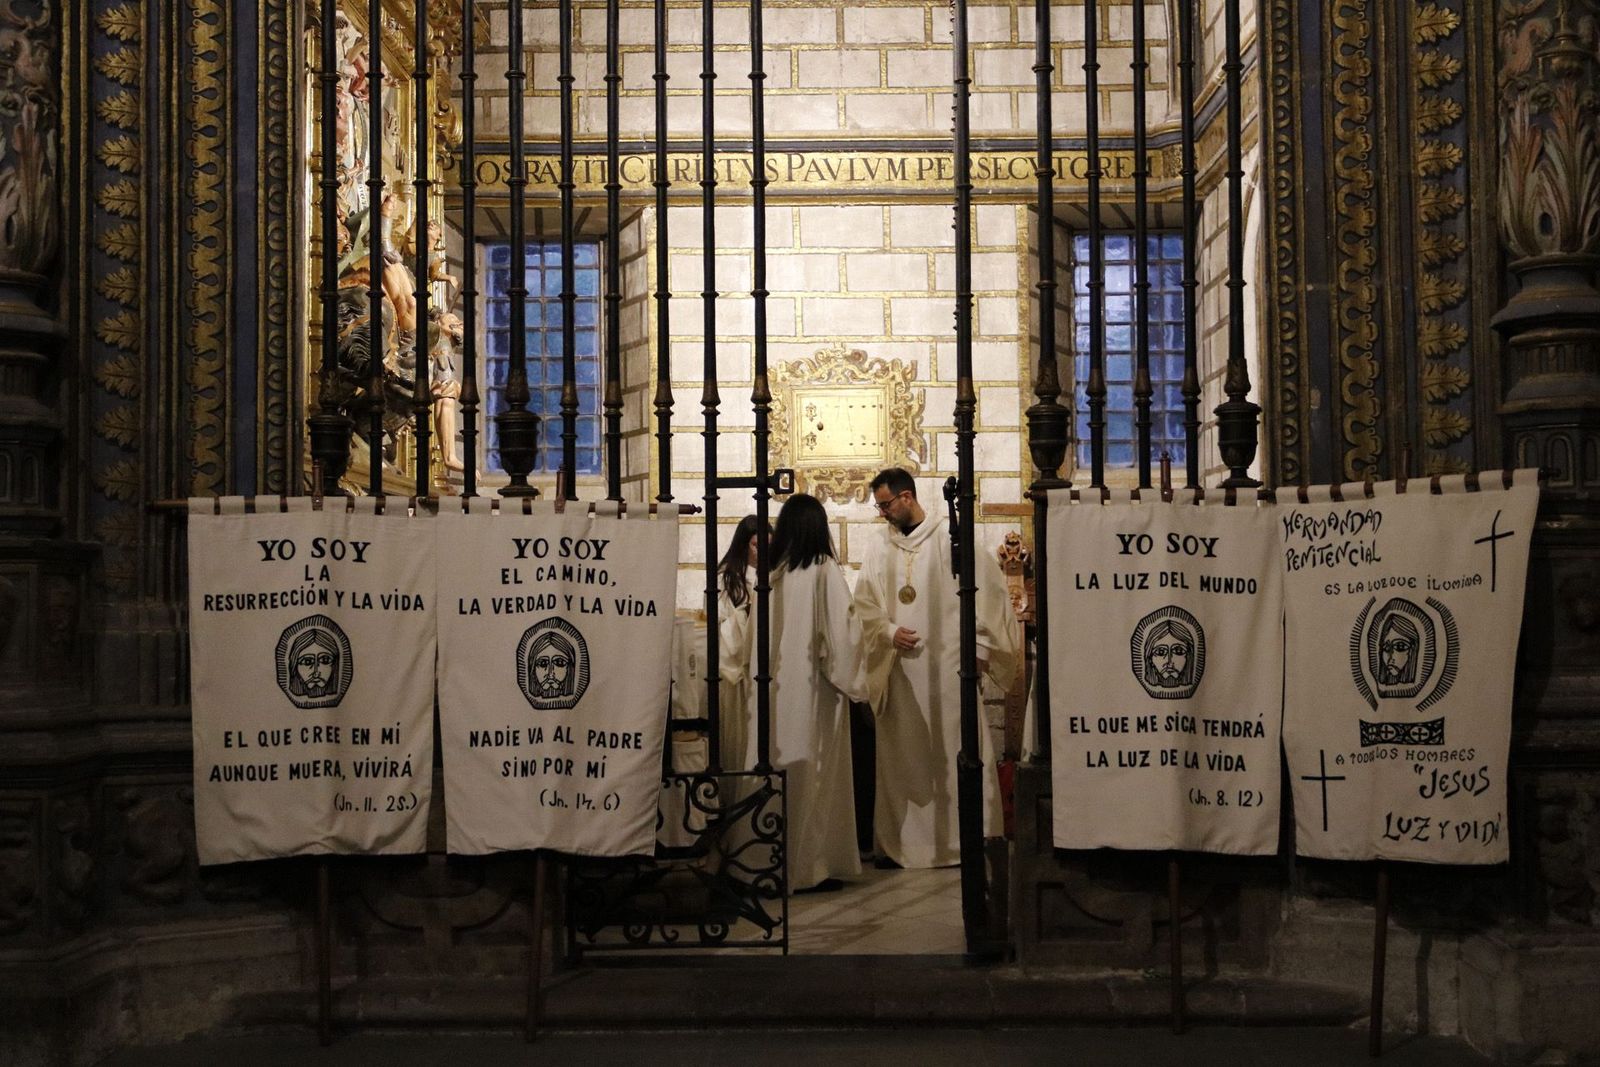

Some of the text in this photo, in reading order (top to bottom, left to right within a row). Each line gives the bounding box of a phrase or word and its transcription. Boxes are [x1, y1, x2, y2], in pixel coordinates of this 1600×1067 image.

[784, 153, 907, 182] PAVLVM
[1283, 509, 1382, 543] HERMANDAD
[257, 538, 371, 563] YO SOY
[512, 537, 610, 560] YO SOY
[1116, 533, 1219, 557] YO SOY
[1286, 539, 1381, 573] PENITENCIAL
[305, 565, 330, 582] LA
[502, 564, 616, 586] EL CAMINO,
[1076, 572, 1257, 594] LA LUZ DEL MUNDO
[1325, 574, 1482, 595] ES LA LUZ QUE ILUMINA
[204, 584, 424, 611] RESURRECCIÓN Y LA VIDA
[459, 594, 656, 616] LA VERDAD Y LA VIDA
[224, 722, 400, 748] EL QUE CREE EN MÍ
[1070, 712, 1264, 738] EL QUE ME SIGA TENDRÁ
[470, 726, 642, 749] NADIE VA AL PADRE
[209, 754, 412, 782] AUNQUE MUERA, VIVIRÁ
[502, 755, 606, 778] SINO POR MÍ
[1087, 749, 1246, 772] LA LUZ DE LA VIDA
[1336, 754, 1344, 765] A
[1406, 748, 1475, 762] HOMBRES
[540, 789, 568, 808] (Jn.
[604, 792, 620, 810] 6)
[1217, 790, 1228, 806] 8.
[1383, 812, 1430, 842] LUZ
[1439, 820, 1450, 839] Y
